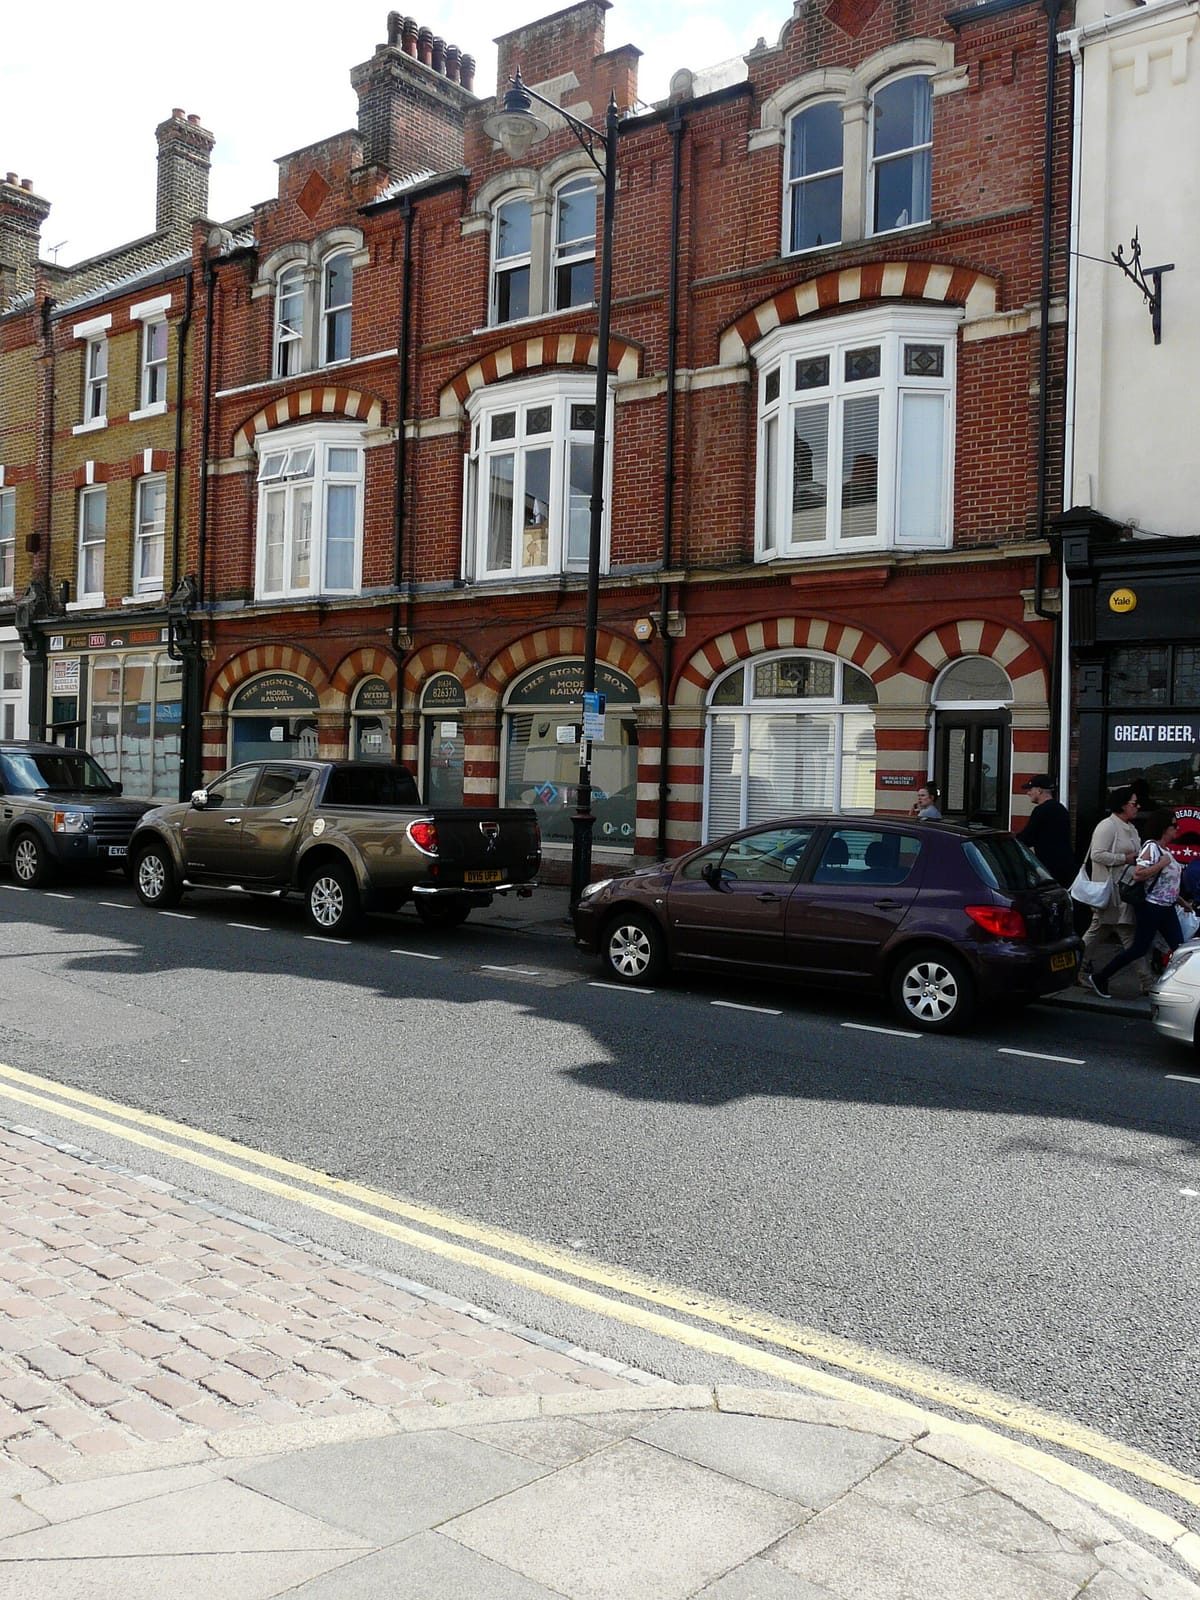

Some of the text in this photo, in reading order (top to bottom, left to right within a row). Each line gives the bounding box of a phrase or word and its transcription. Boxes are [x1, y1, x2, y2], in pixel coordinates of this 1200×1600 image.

[1113, 597, 1131, 605] Yale
[91, 635, 105, 646] PECO
[521, 667, 629, 695] THE SIGN BOX
[558, 681, 584, 689] MODE
[240, 678, 315, 702] THE SIGNAL BOX
[432, 687, 458, 698] 826370
[1114, 726, 1155, 741] GREAT
[1158, 726, 1196, 743] BEER,
[1175, 809, 1193, 819] DEAD
